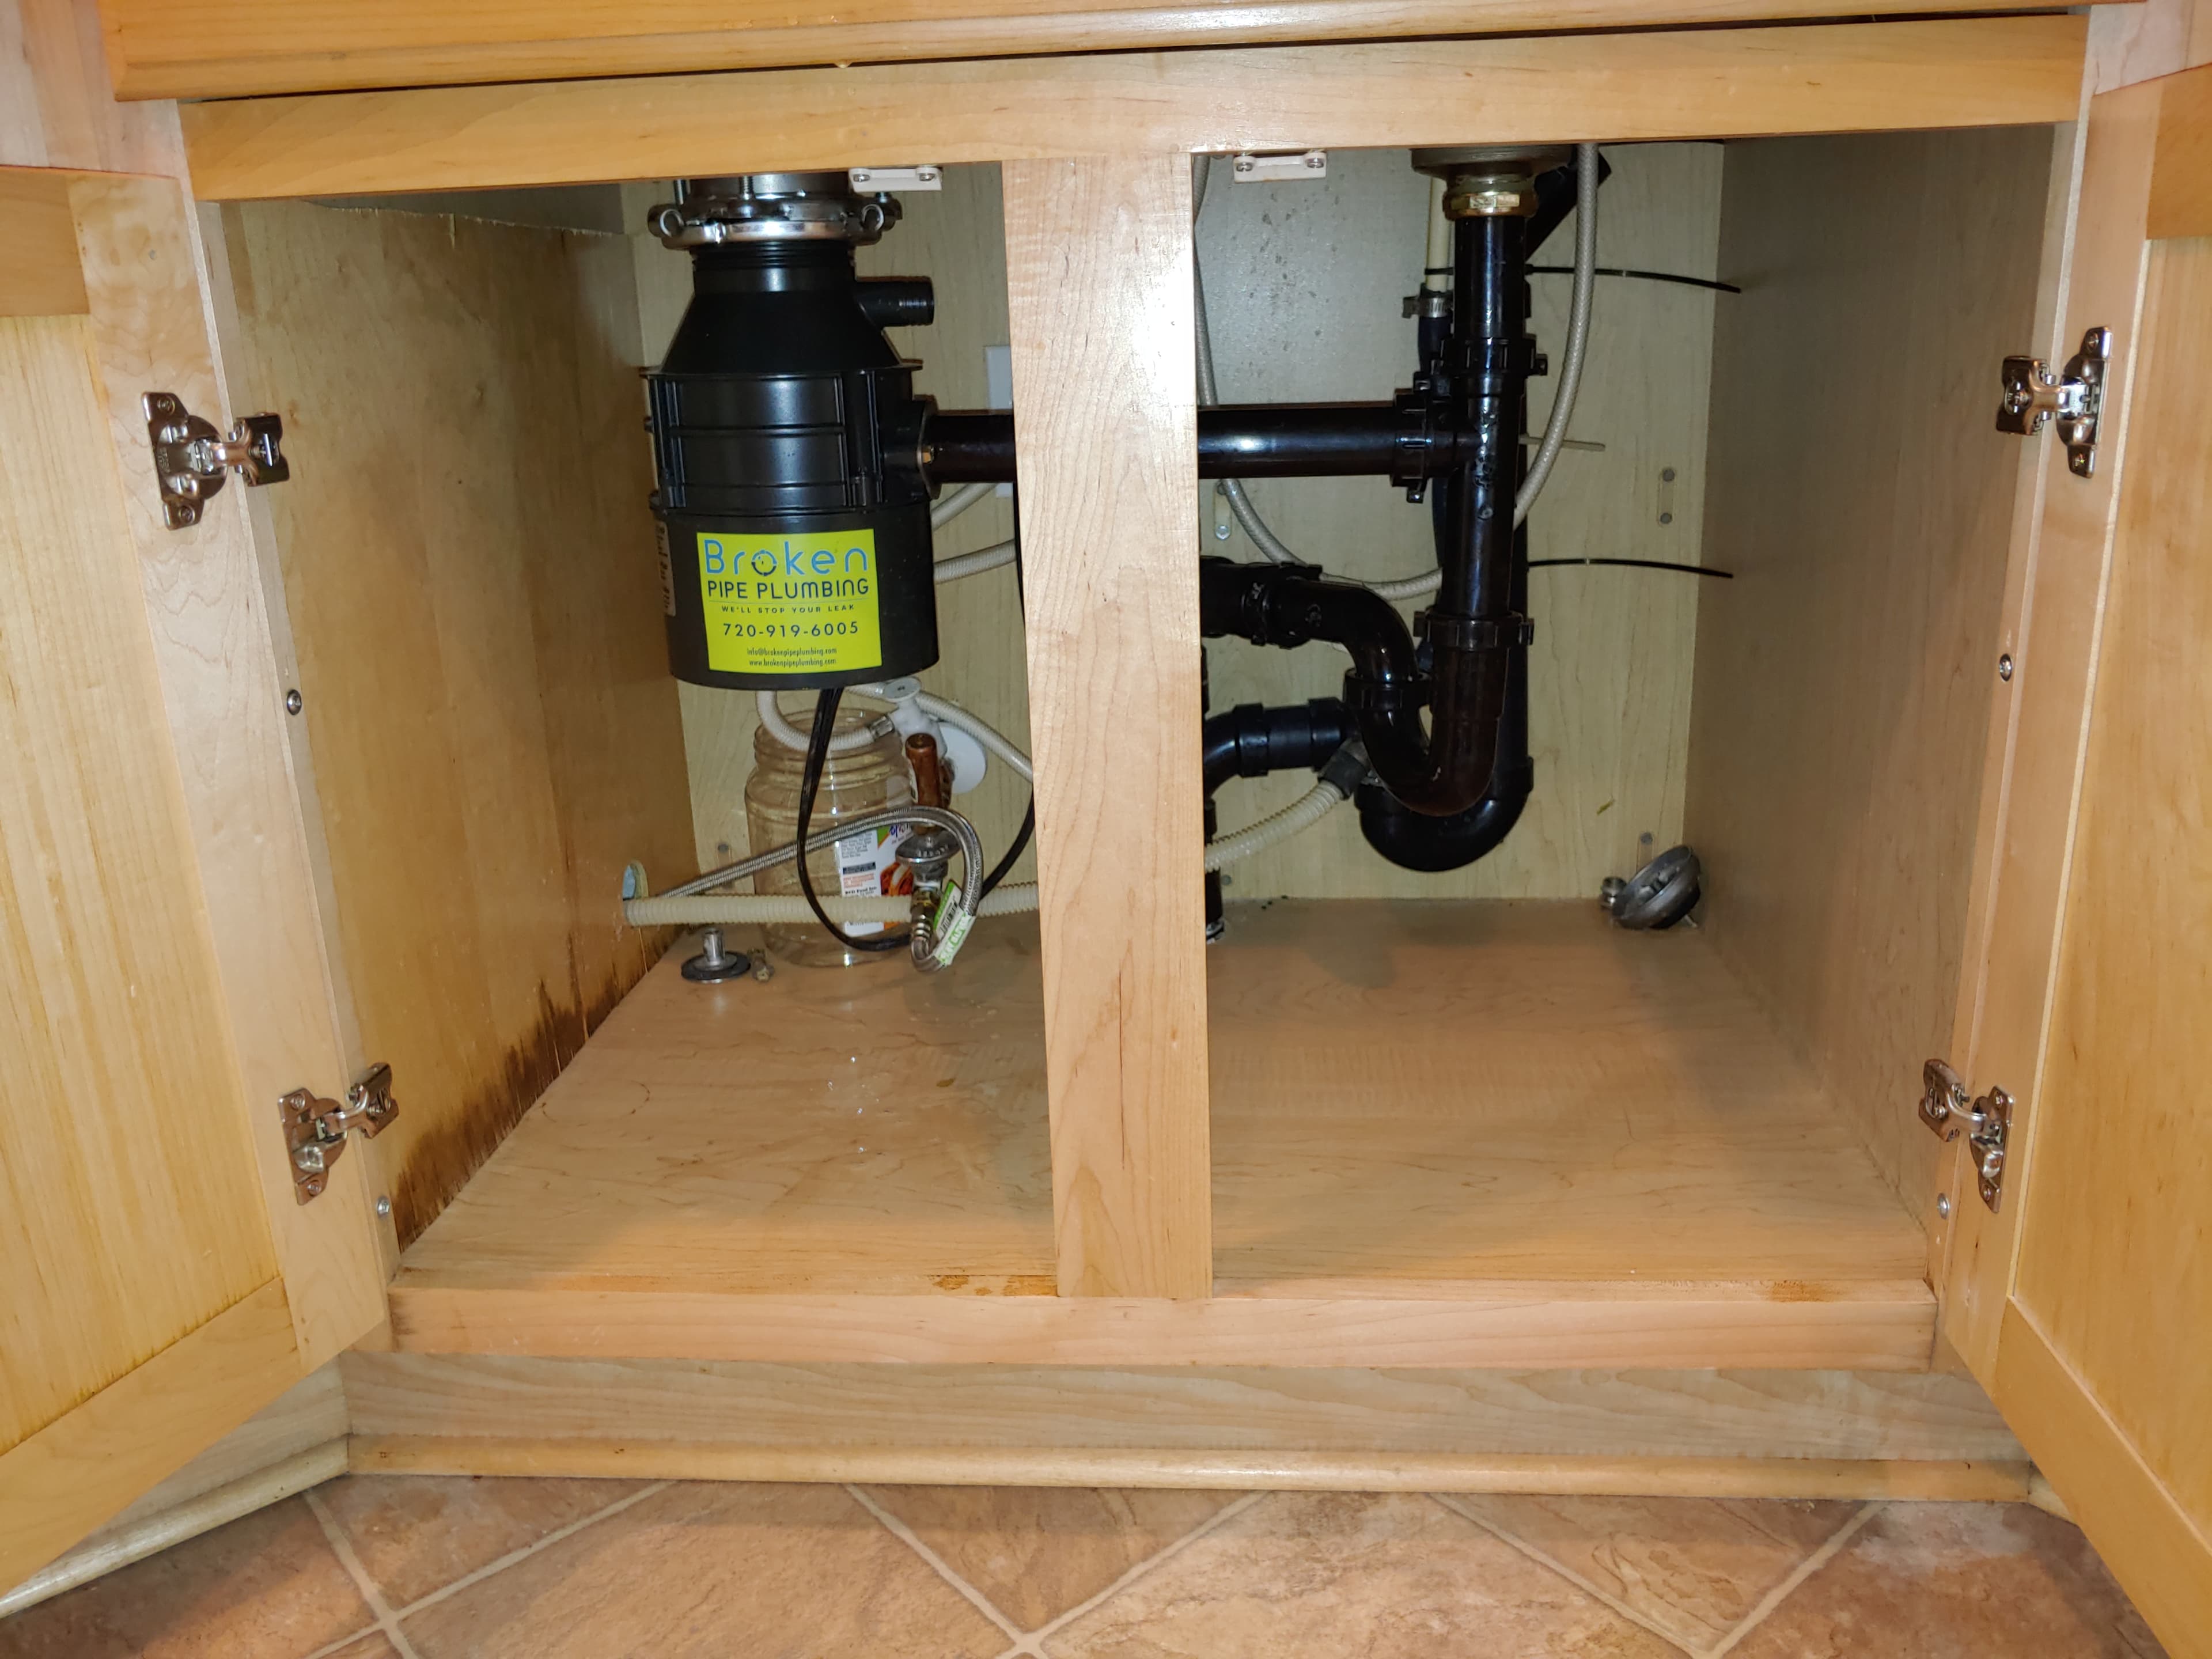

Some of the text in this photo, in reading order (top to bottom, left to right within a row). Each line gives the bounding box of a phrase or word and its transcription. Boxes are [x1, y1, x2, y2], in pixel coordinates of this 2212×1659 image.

[704, 539, 867, 576] Broken
[707, 578, 869, 599] PIPE PLUMBING
[722, 605, 751, 613] WE'LL
[828, 604, 855, 612] LEAK
[723, 621, 858, 638] 720-919-6005
[747, 647, 837, 658] info@brokenpipeplumbing.com
[749, 658, 836, 668] www.brokenpipeplumbing.com
